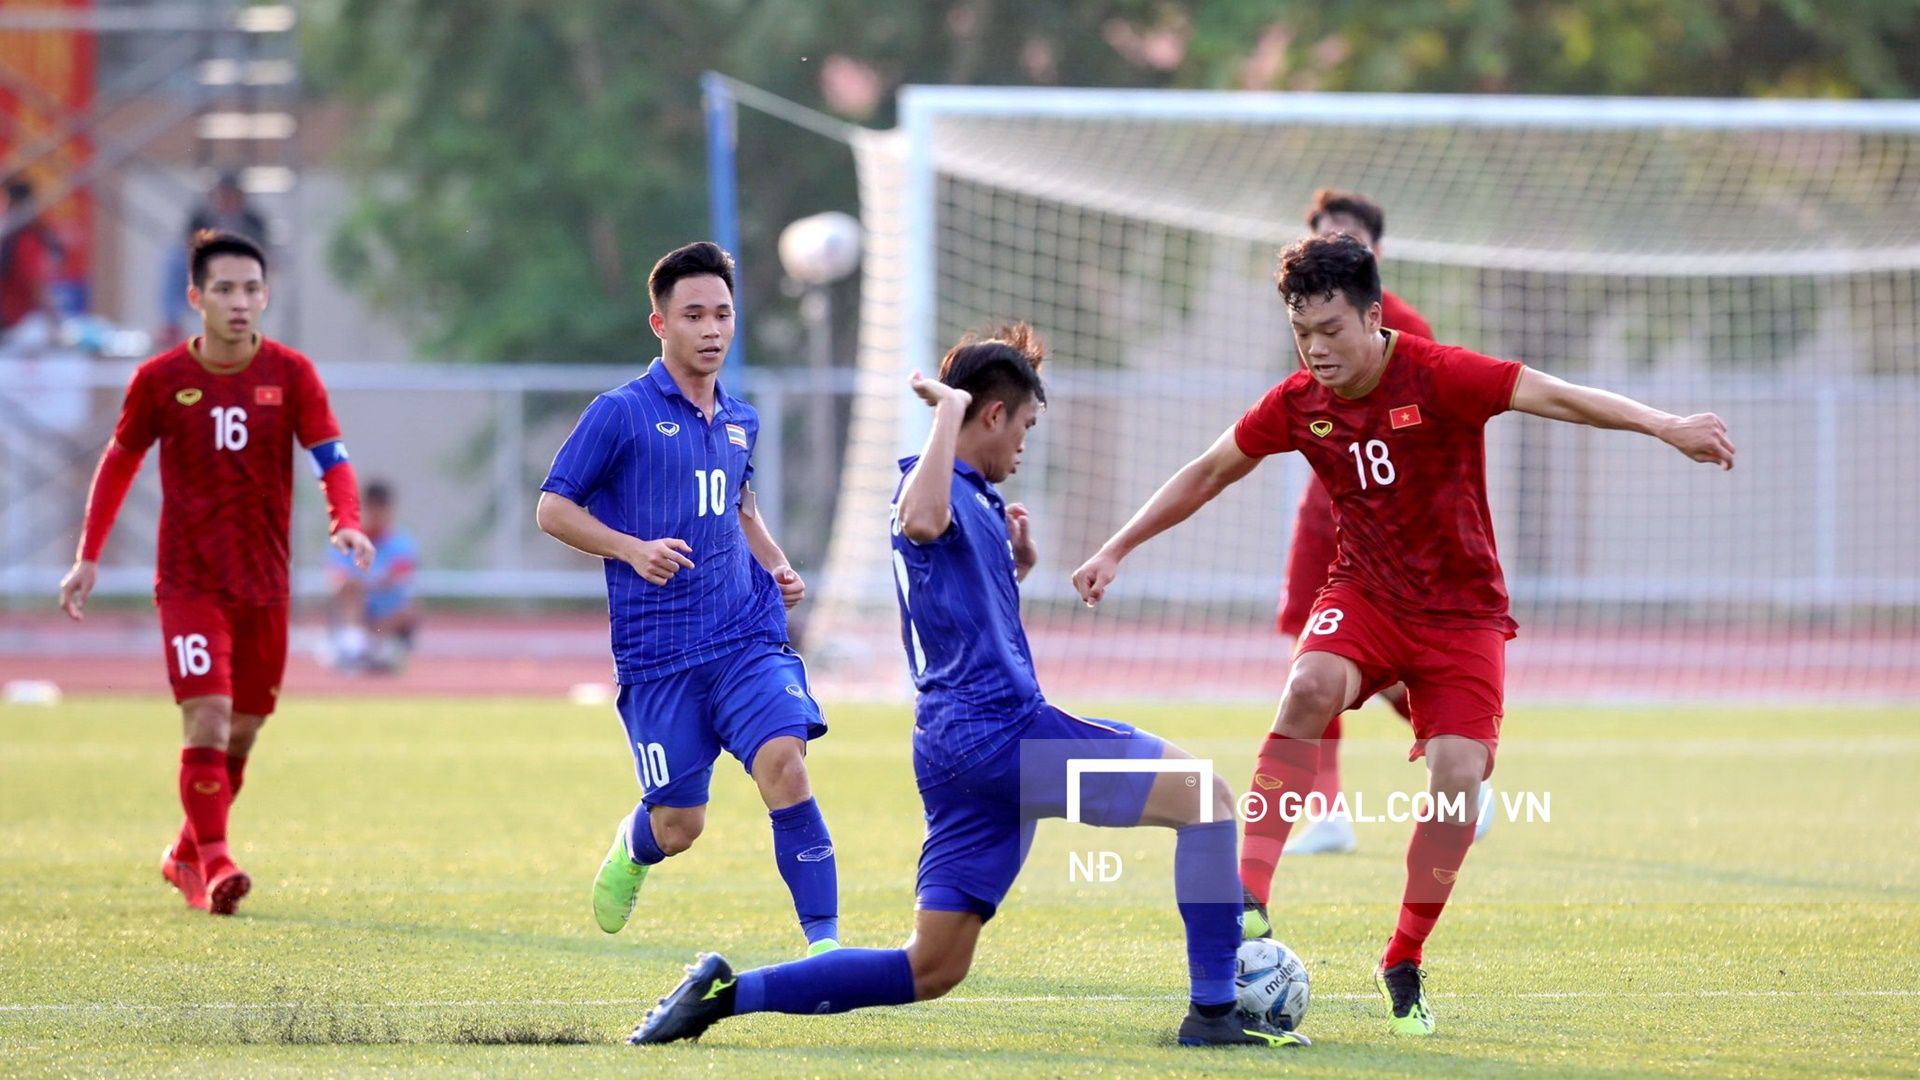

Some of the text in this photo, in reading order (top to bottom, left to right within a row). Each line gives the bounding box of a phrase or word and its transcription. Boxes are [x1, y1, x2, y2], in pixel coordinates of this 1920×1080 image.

[211, 406, 248, 451] 16
[1348, 439, 1396, 490] 18
[695, 468, 727, 517] 10
[172, 634, 212, 679] 16
[636, 742, 670, 789] 10
[1265, 959, 1299, 995] molten
